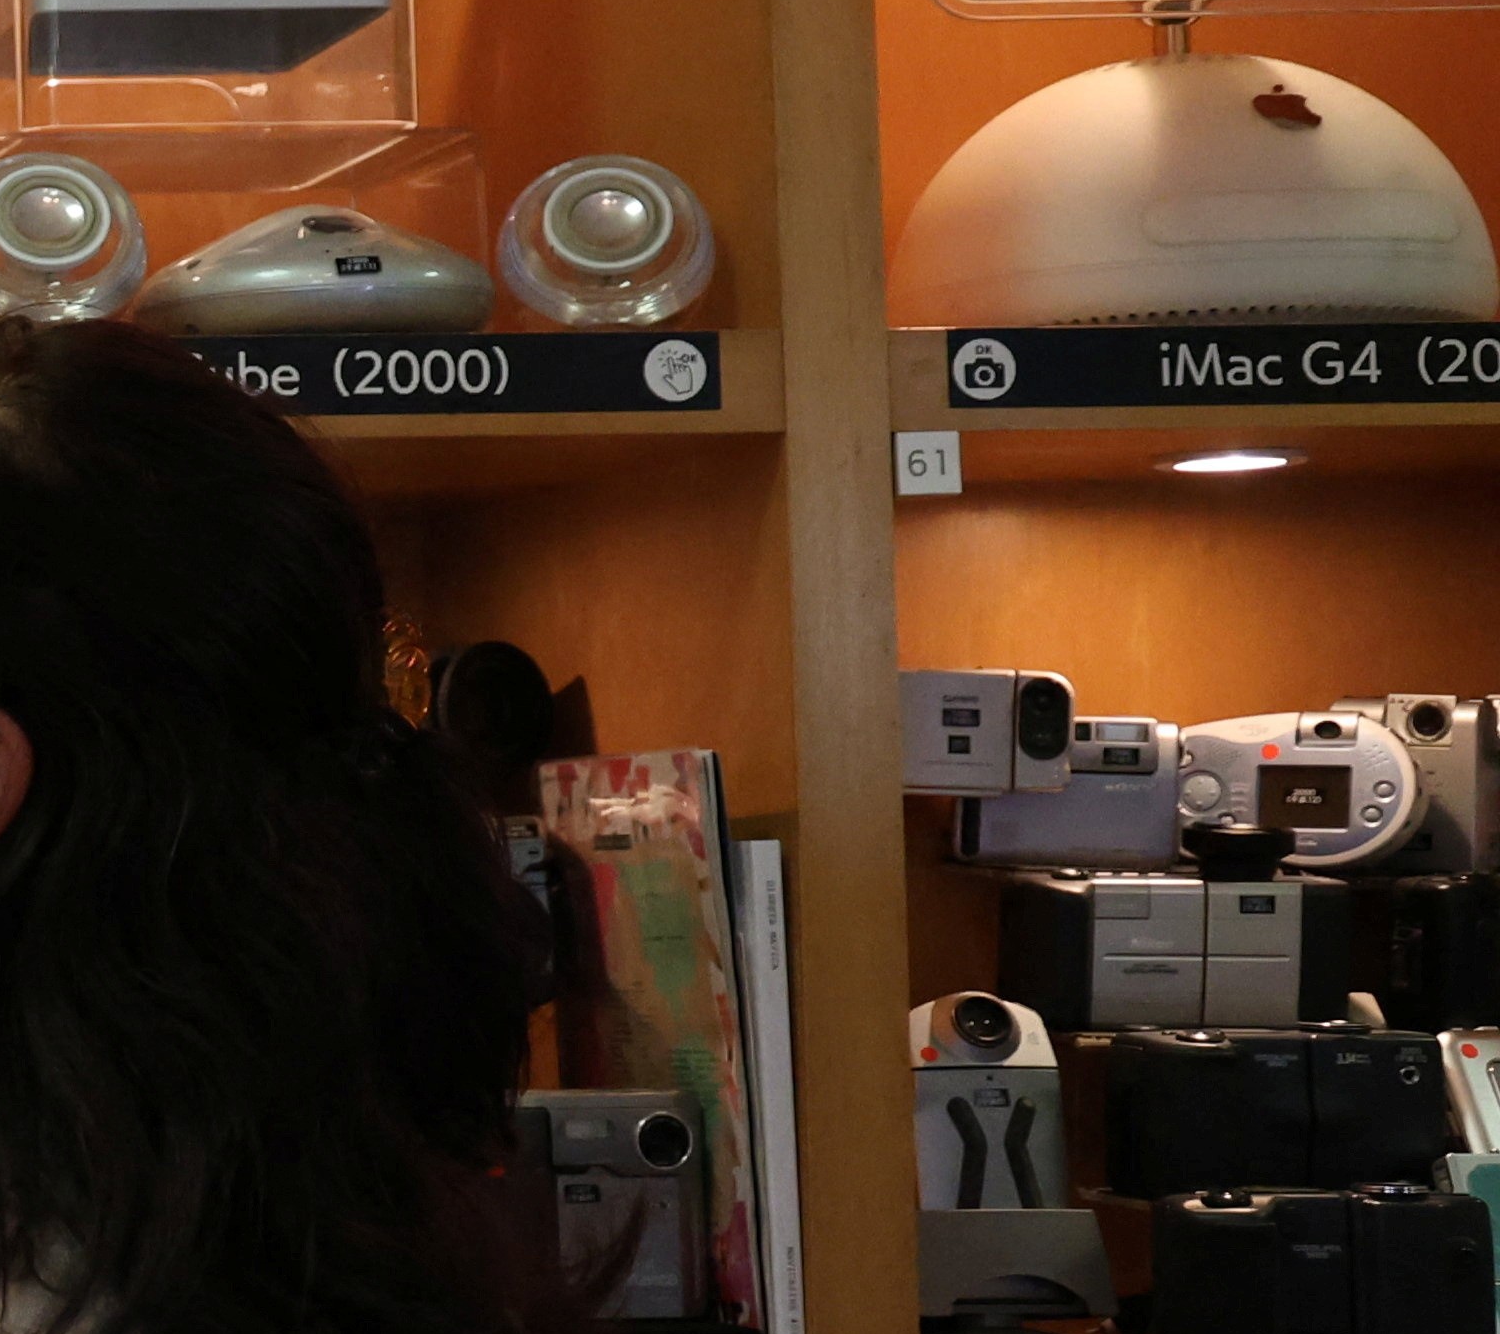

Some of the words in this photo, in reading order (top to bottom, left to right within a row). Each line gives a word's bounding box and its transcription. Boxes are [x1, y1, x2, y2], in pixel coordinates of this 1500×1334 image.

[333, 345, 511, 397] (2000)
[1160, 340, 1284, 388] iMac
[1301, 339, 1383, 386] G4
[907, 448, 947, 477] 61
